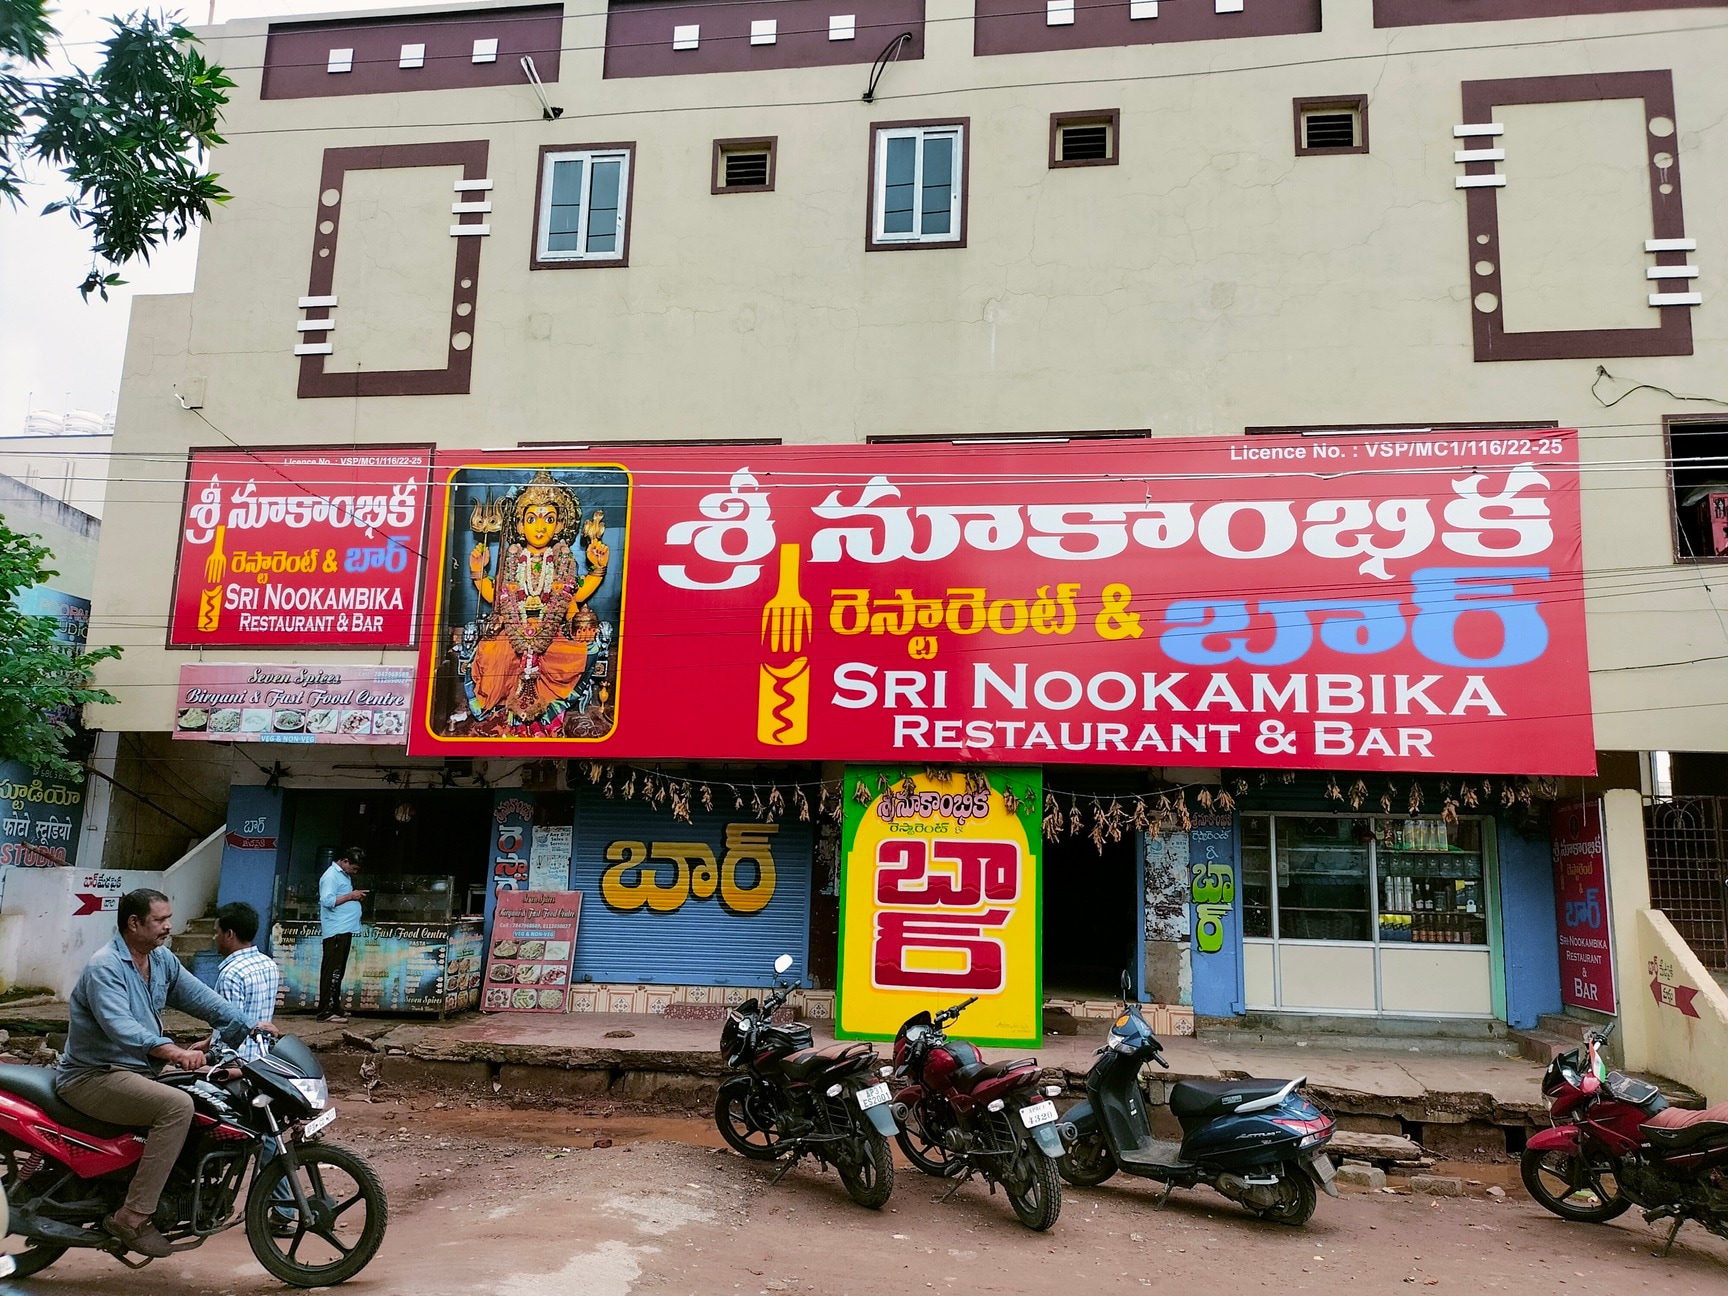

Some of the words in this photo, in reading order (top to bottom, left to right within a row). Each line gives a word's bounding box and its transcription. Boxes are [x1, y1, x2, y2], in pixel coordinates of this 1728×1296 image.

[1230, 444, 1307, 460] Licence
[1313, 443, 1346, 459] No.
[1365, 439, 1563, 458] VSP/MC1/116/22-25
[340, 456, 422, 466] VSP/MC1/116/22-25
[185, 473, 222, 544] శ్రీ
[657, 466, 777, 590] శ్రీ
[322, 549, 338, 573] &
[343, 536, 411, 573] బార్
[224, 583, 260, 610] SRI
[263, 583, 404, 611] NOOKAMBIKA
[239, 612, 335, 633] RESTAURANT
[336, 612, 349, 633] &
[351, 612, 384, 633] BAR
[829, 582, 1081, 660] రెస్టారెంట్
[1095, 582, 1144, 640] &
[1159, 566, 1551, 668] బార్
[247, 667, 290, 685] Seven
[293, 668, 343, 688] Spices
[185, 687, 247, 707] Biryani
[250, 690, 262, 705] &
[264, 689, 304, 708] Fast
[306, 688, 354, 708] Food
[355, 690, 405, 707] Centre
[831, 661, 946, 710] SRI
[972, 662, 1508, 717] NOOKAMBIKA
[261, 735, 276, 743] VEG
[283, 735, 315, 744] NON-VEG
[892, 714, 1241, 755] RESTAURANT
[1254, 719, 1297, 756] &
[1313, 720, 1435, 758] BAR
[244, 816, 267, 833] బార్
[601, 822, 780, 914] బార్
[280, 926, 299, 936] even
[395, 926, 420, 939] Food
[1566, 950, 1602, 964] RESTAURANT
[1581, 967, 1587, 978] &
[1574, 977, 1599, 1001] BAR
